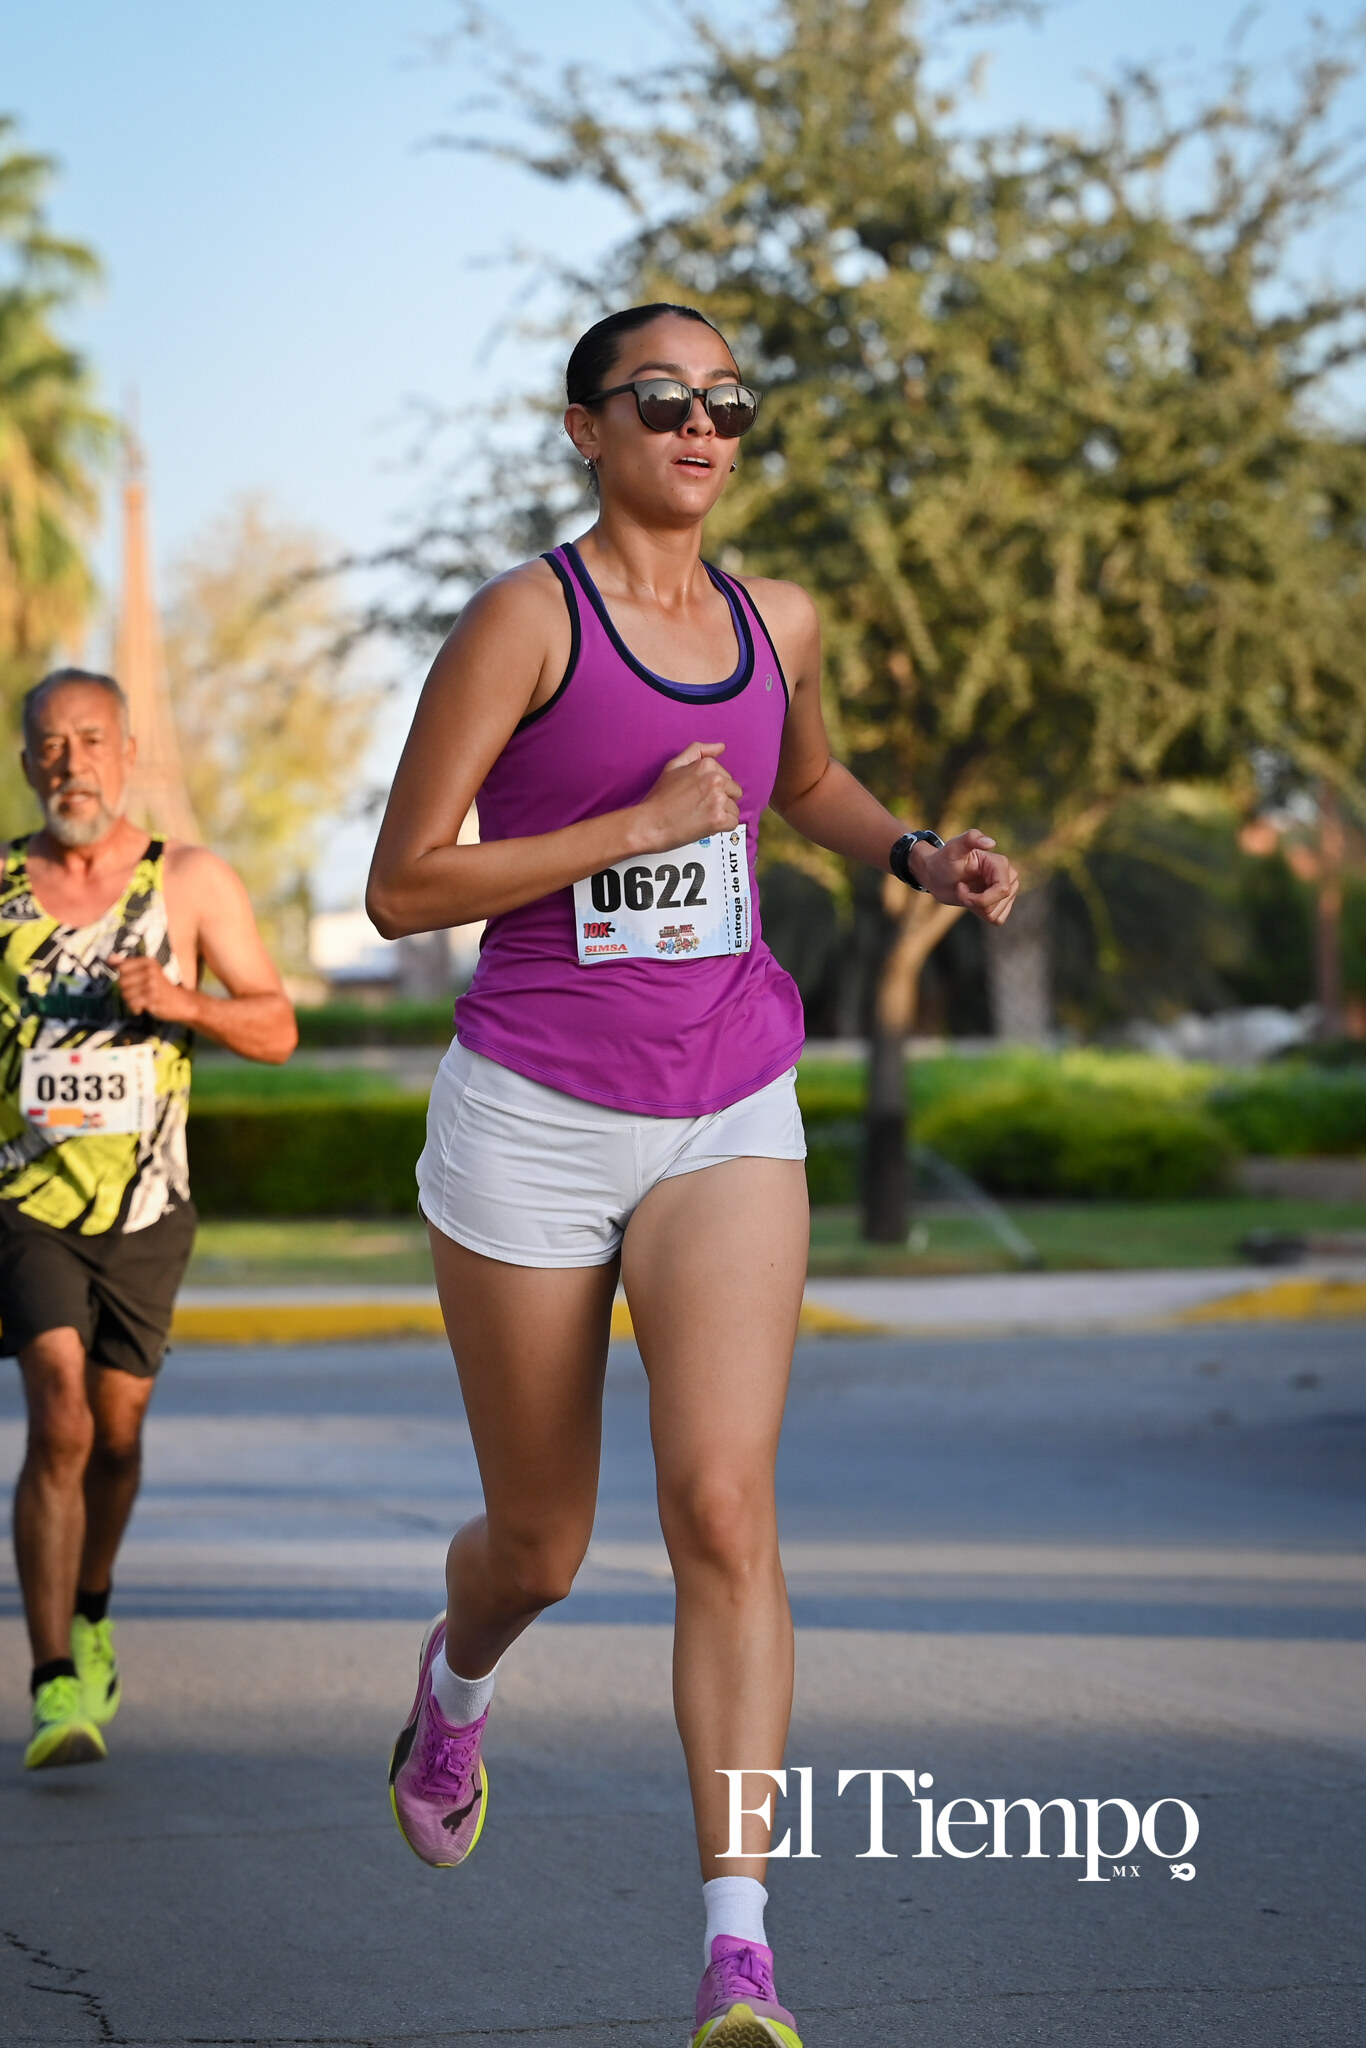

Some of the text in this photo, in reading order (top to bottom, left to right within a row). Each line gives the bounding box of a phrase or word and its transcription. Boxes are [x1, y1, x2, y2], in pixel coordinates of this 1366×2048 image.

[590, 862, 708, 913] 0622
[729, 851, 743, 948] Entrega de KIT
[583, 922, 612, 939] 10K
[584, 944, 628, 953] SIMSA
[37, 1074, 126, 1102] 0333
